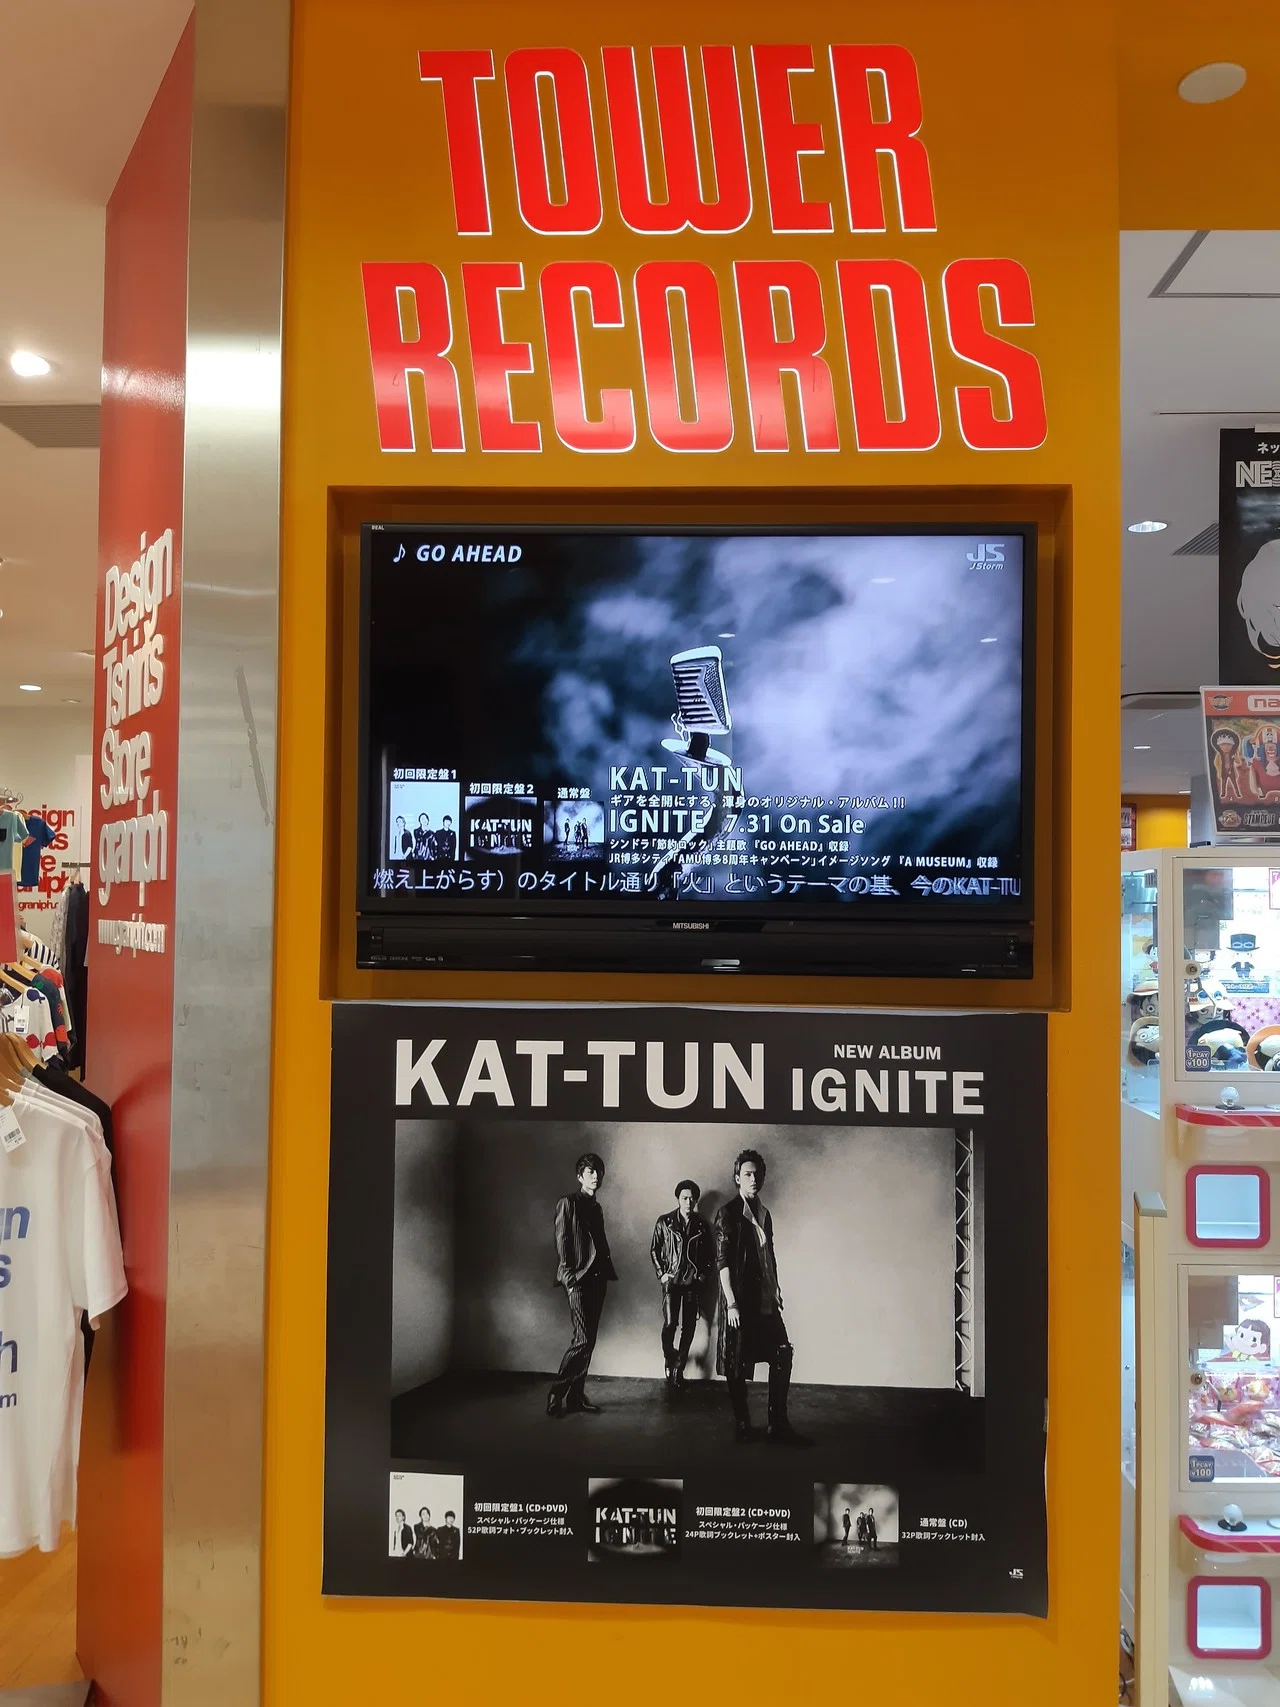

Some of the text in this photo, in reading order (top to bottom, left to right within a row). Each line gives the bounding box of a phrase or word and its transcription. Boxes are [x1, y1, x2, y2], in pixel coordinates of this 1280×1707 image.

[417, 44, 937, 236] TOWER
[361, 257, 1049, 454] RECORDS
[416, 544, 522, 563] GO AHEAD
[966, 543, 1005, 562] JS
[103, 527, 174, 647] Design
[102, 628, 165, 728] Tshirts
[100, 727, 152, 811] Store
[393, 767, 457, 780] 初回限定盤1
[609, 766, 743, 792] KAT-TUN
[469, 782, 535, 795] 初回限定盤2
[557, 787, 592, 799] 通常盤
[609, 809, 866, 834] IGNITE 7.31 On Sale
[99, 789, 169, 907] graniph
[672, 922, 710, 930] MITSUBISHI
[833, 1044, 942, 1060] NEW ALBUM
[395, 1038, 764, 1110] KAT-TUN
[791, 1067, 984, 1115] IGNITE
[525, 1503, 568, 1514] (CD+DVD)
[748, 1507, 791, 1520] (CD+DVD)
[919, 1517, 968, 1529] 通常盤 (CD)
